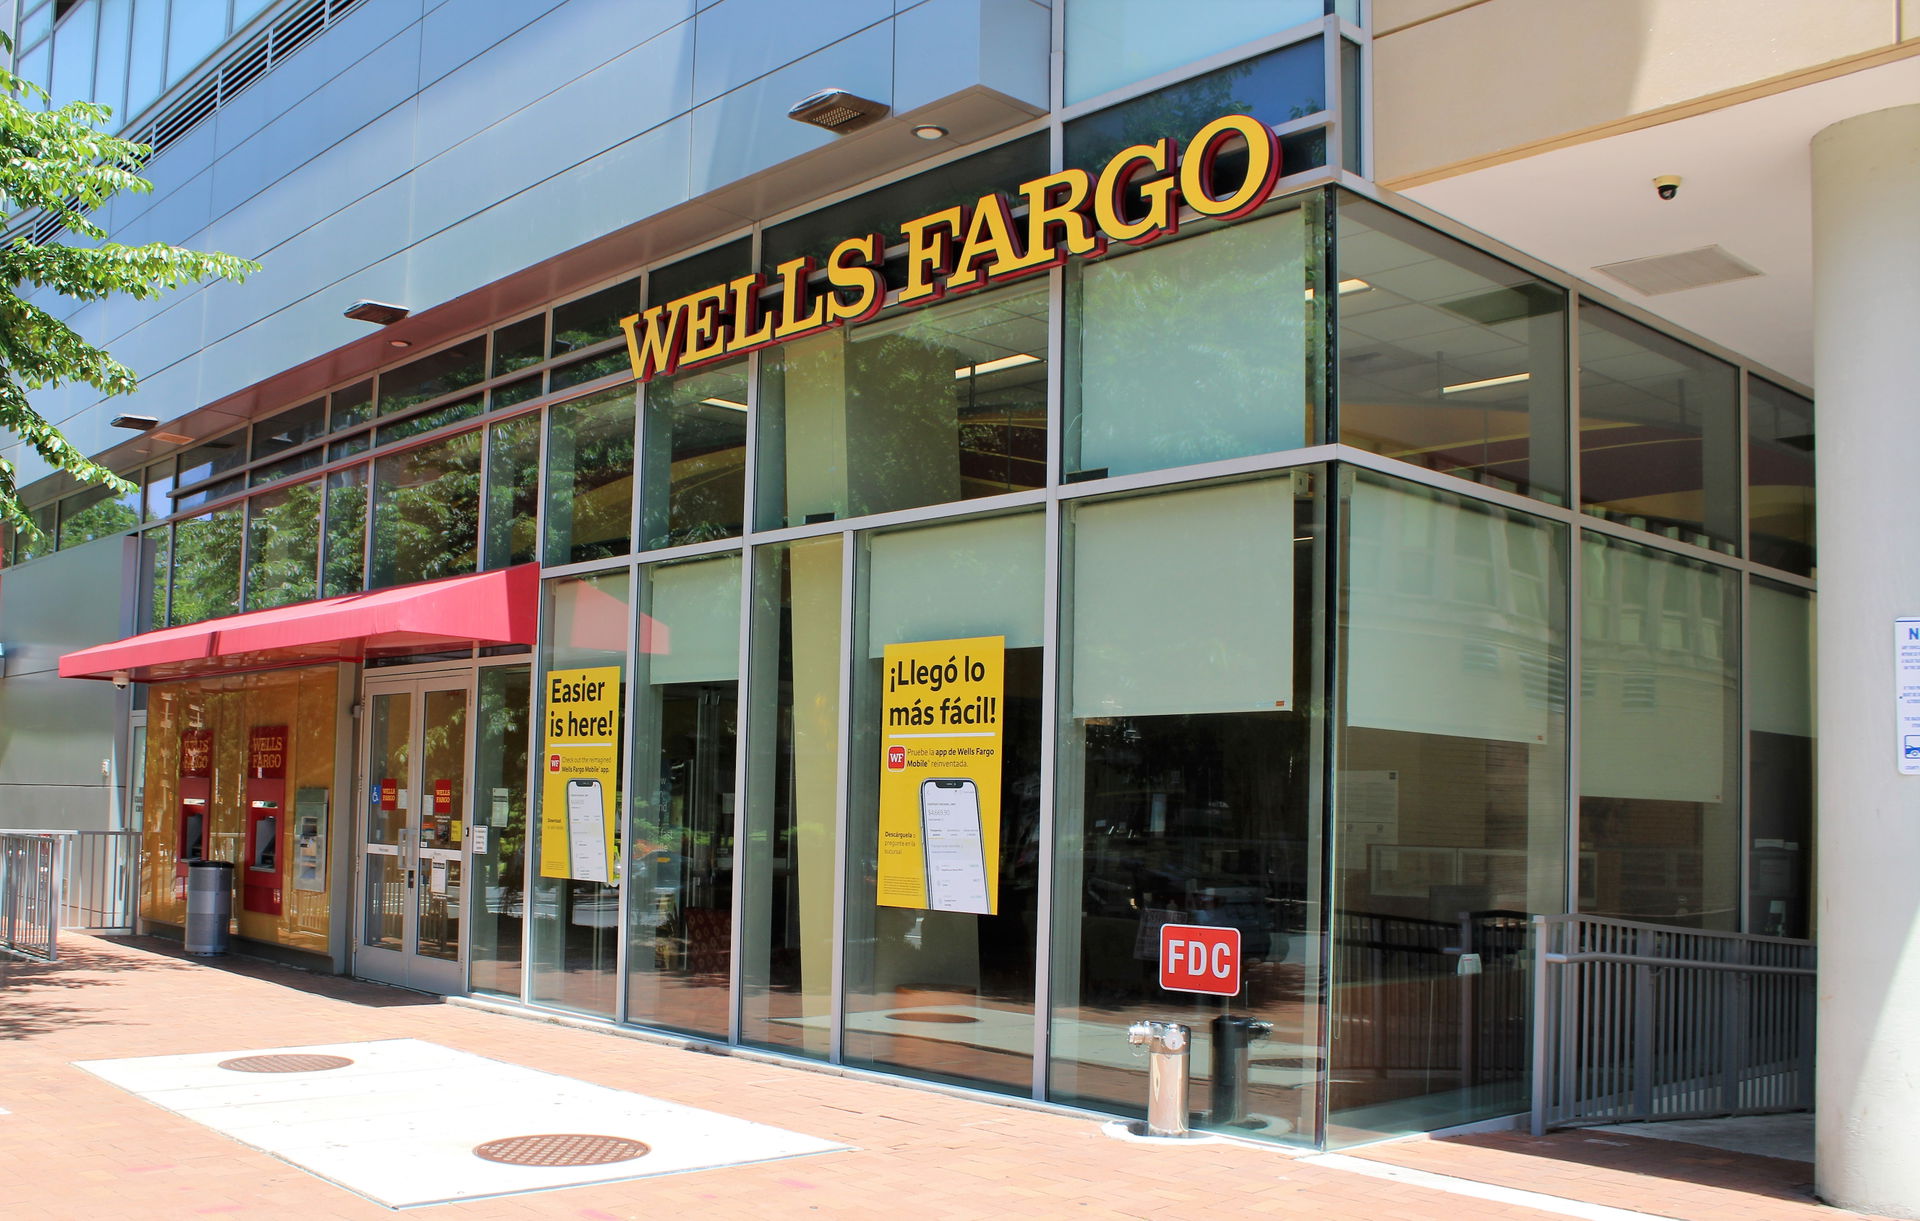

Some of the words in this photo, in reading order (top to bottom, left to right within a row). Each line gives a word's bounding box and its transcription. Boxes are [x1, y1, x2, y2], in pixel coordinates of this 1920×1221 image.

[619, 233, 885, 382] WELLS
[898, 114, 1282, 307] FARGO
[890, 655, 958, 692] ¡Llegó
[964, 655, 985, 682] lo
[552, 674, 606, 704] Easier
[889, 698, 935, 727] más
[939, 695, 996, 725] fácil!
[550, 710, 564, 737] is
[568, 710, 614, 737] here!
[252, 736, 282, 752] WELLS
[907, 748, 928, 757] Pruebe
[935, 749, 947, 758] app
[948, 747, 956, 756] de
[957, 747, 975, 756] Wells
[976, 747, 995, 758] Fargo
[252, 754, 281, 769] FARGO
[890, 753, 904, 763] WF
[931, 760, 968, 768] reinventada.
[573, 765, 584, 775] Fargo
[1168, 939, 1231, 979] FDC
